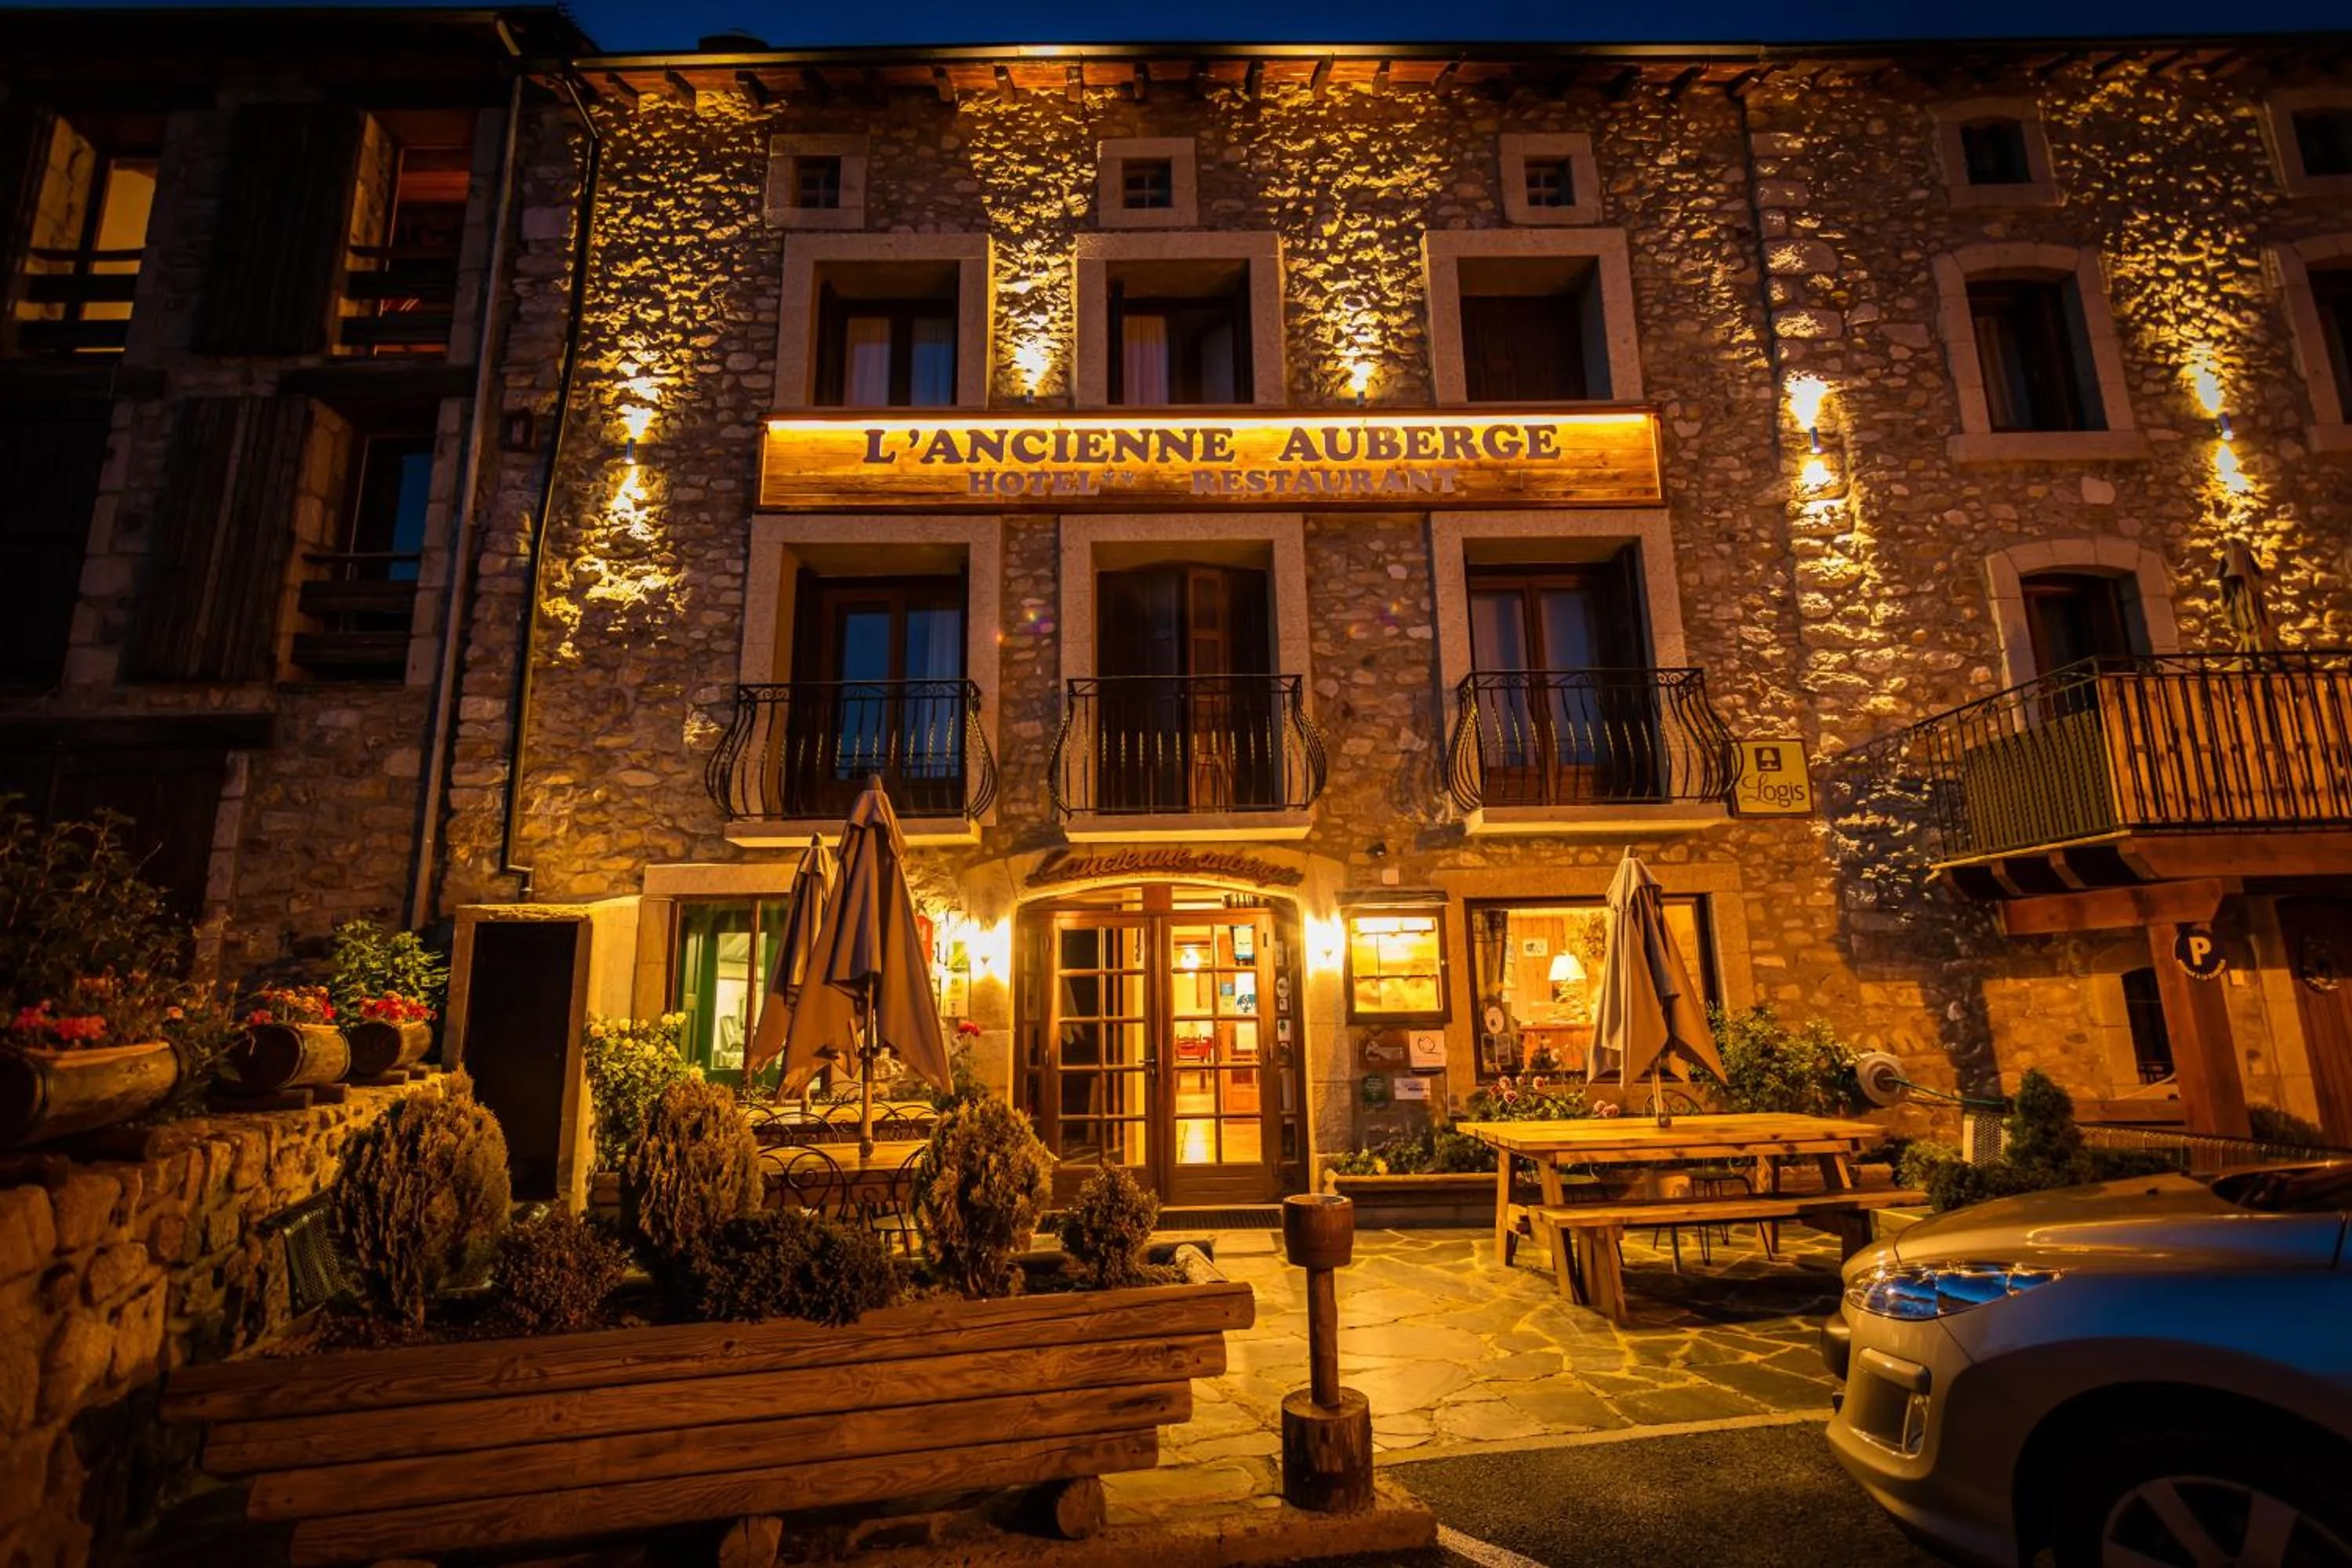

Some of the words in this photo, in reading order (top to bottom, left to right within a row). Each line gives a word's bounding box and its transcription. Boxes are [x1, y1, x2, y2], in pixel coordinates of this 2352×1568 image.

[863, 428, 1236, 464] L'ANCIENNE
[1279, 425, 1561, 461] AUBERGE
[1190, 468, 1458, 495] RESTAURANT
[1741, 772, 1806, 808] Logis
[2189, 937, 2211, 965] P
